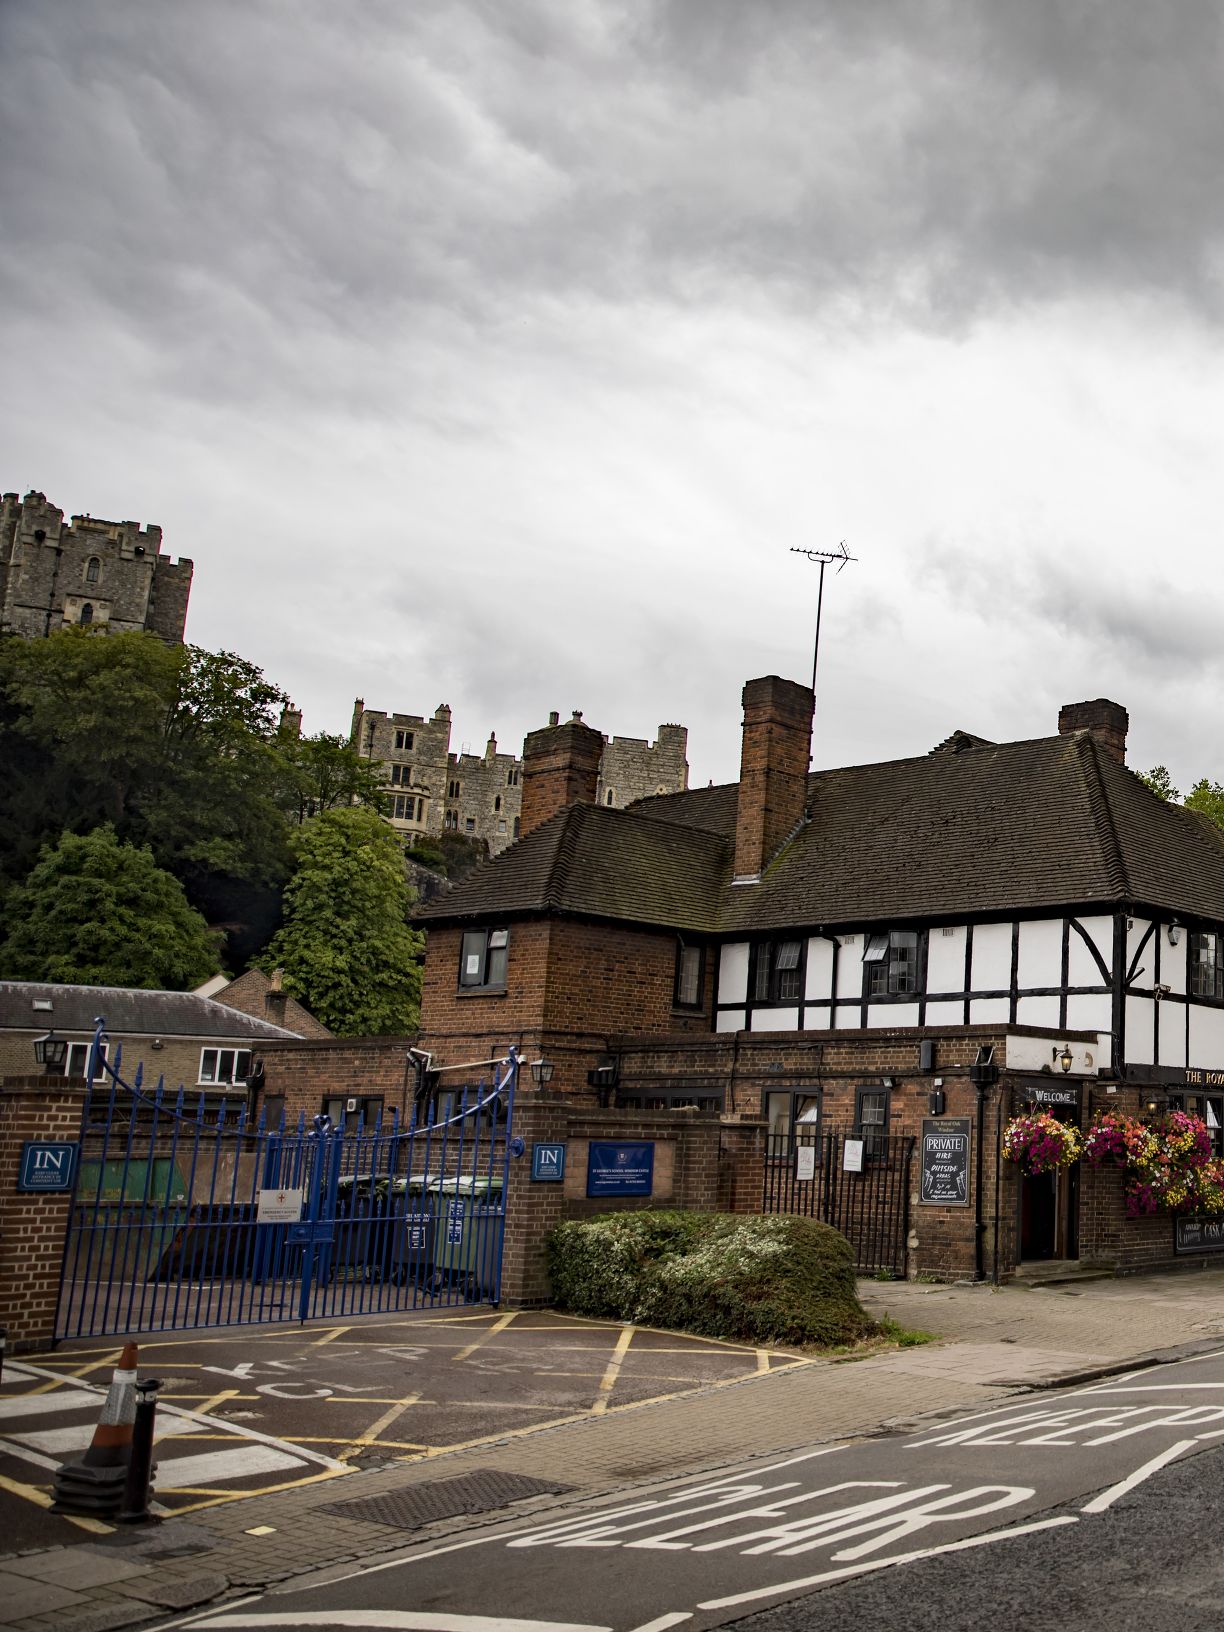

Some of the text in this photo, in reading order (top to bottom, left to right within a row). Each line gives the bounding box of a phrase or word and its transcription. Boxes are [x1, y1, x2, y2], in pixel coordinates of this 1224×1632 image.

[1185, 1070, 1201, 1083] THE
[928, 1138, 960, 1150] PRIVATE
[33, 1151, 65, 1169] IN
[540, 1150, 559, 1164] IN
[505, 1481, 1037, 1562] CLEAR
